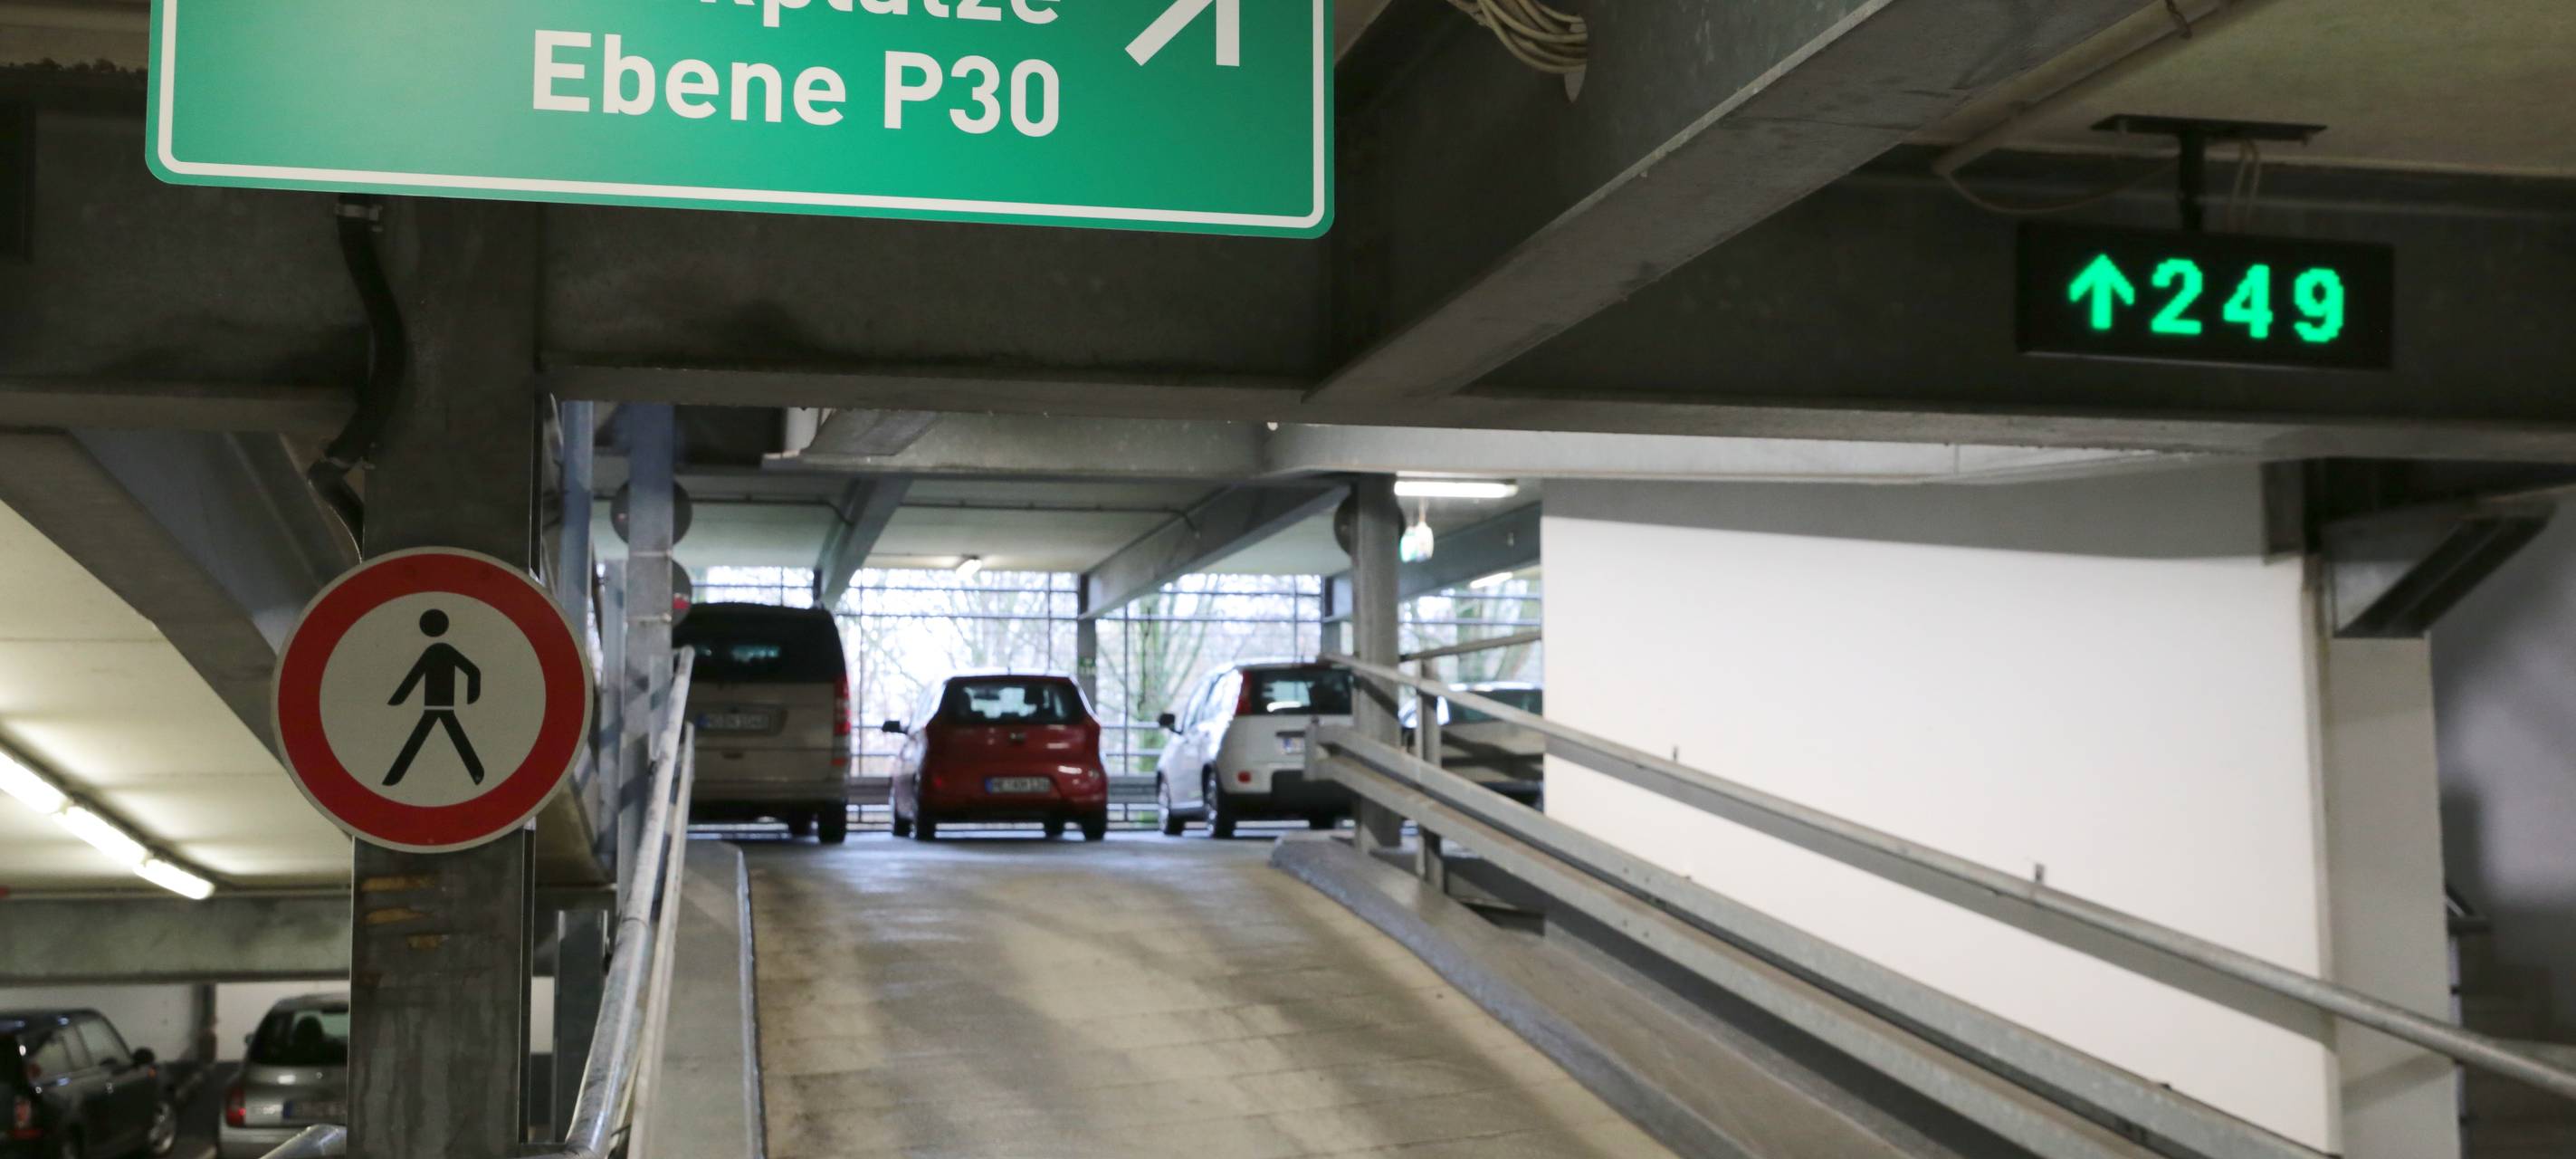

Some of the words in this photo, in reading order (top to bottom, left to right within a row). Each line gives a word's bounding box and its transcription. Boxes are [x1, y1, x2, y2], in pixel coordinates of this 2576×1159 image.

[533, 29, 846, 126] Ebene
[884, 51, 1059, 137] P30
[2150, 257, 2344, 343] 249
